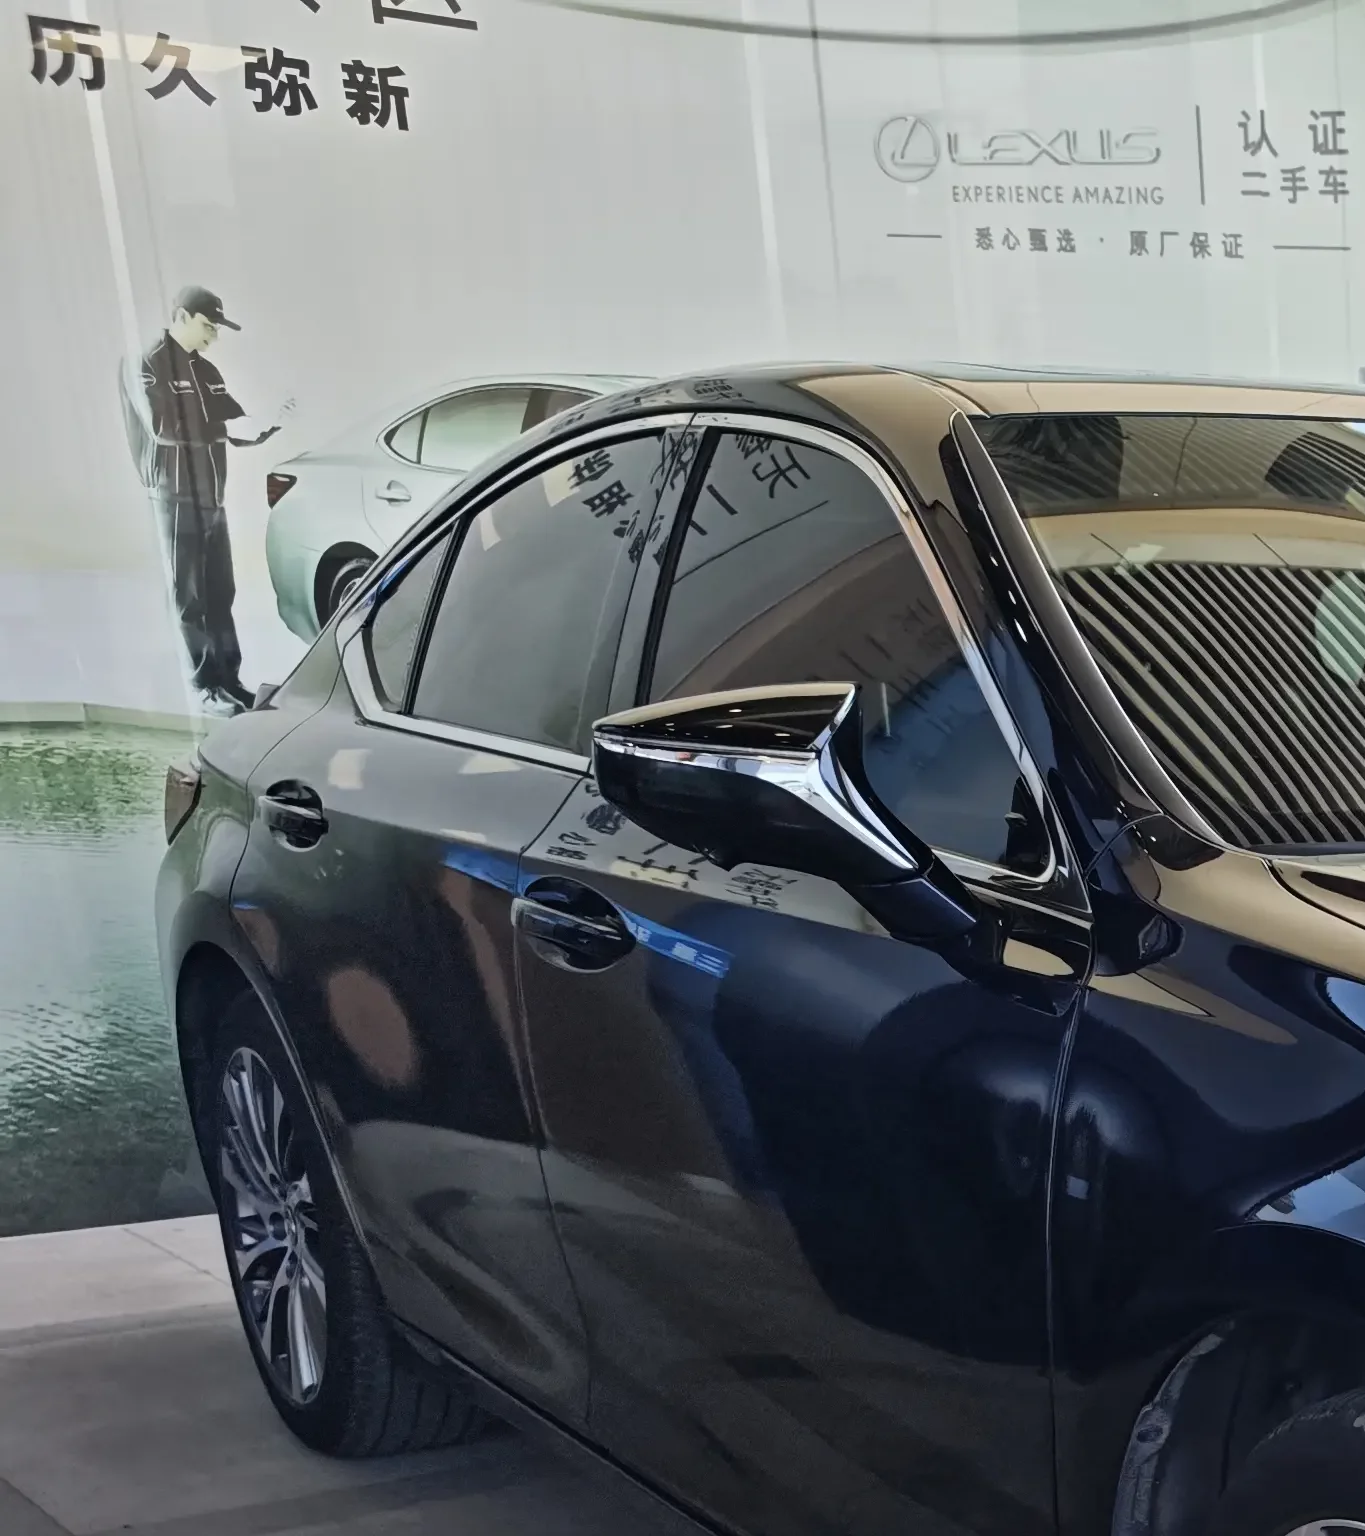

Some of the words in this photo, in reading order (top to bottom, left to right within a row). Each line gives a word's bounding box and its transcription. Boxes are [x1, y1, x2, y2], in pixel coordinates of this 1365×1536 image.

[27, 14, 410, 131] 历久弥新
[947, 127, 1162, 166] LEXUS
[1237, 109, 1349, 158] 认证
[952, 185, 1065, 204] EXPERIENCE
[1071, 186, 1165, 206] AMAZING
[1240, 165, 1350, 204] 二手车
